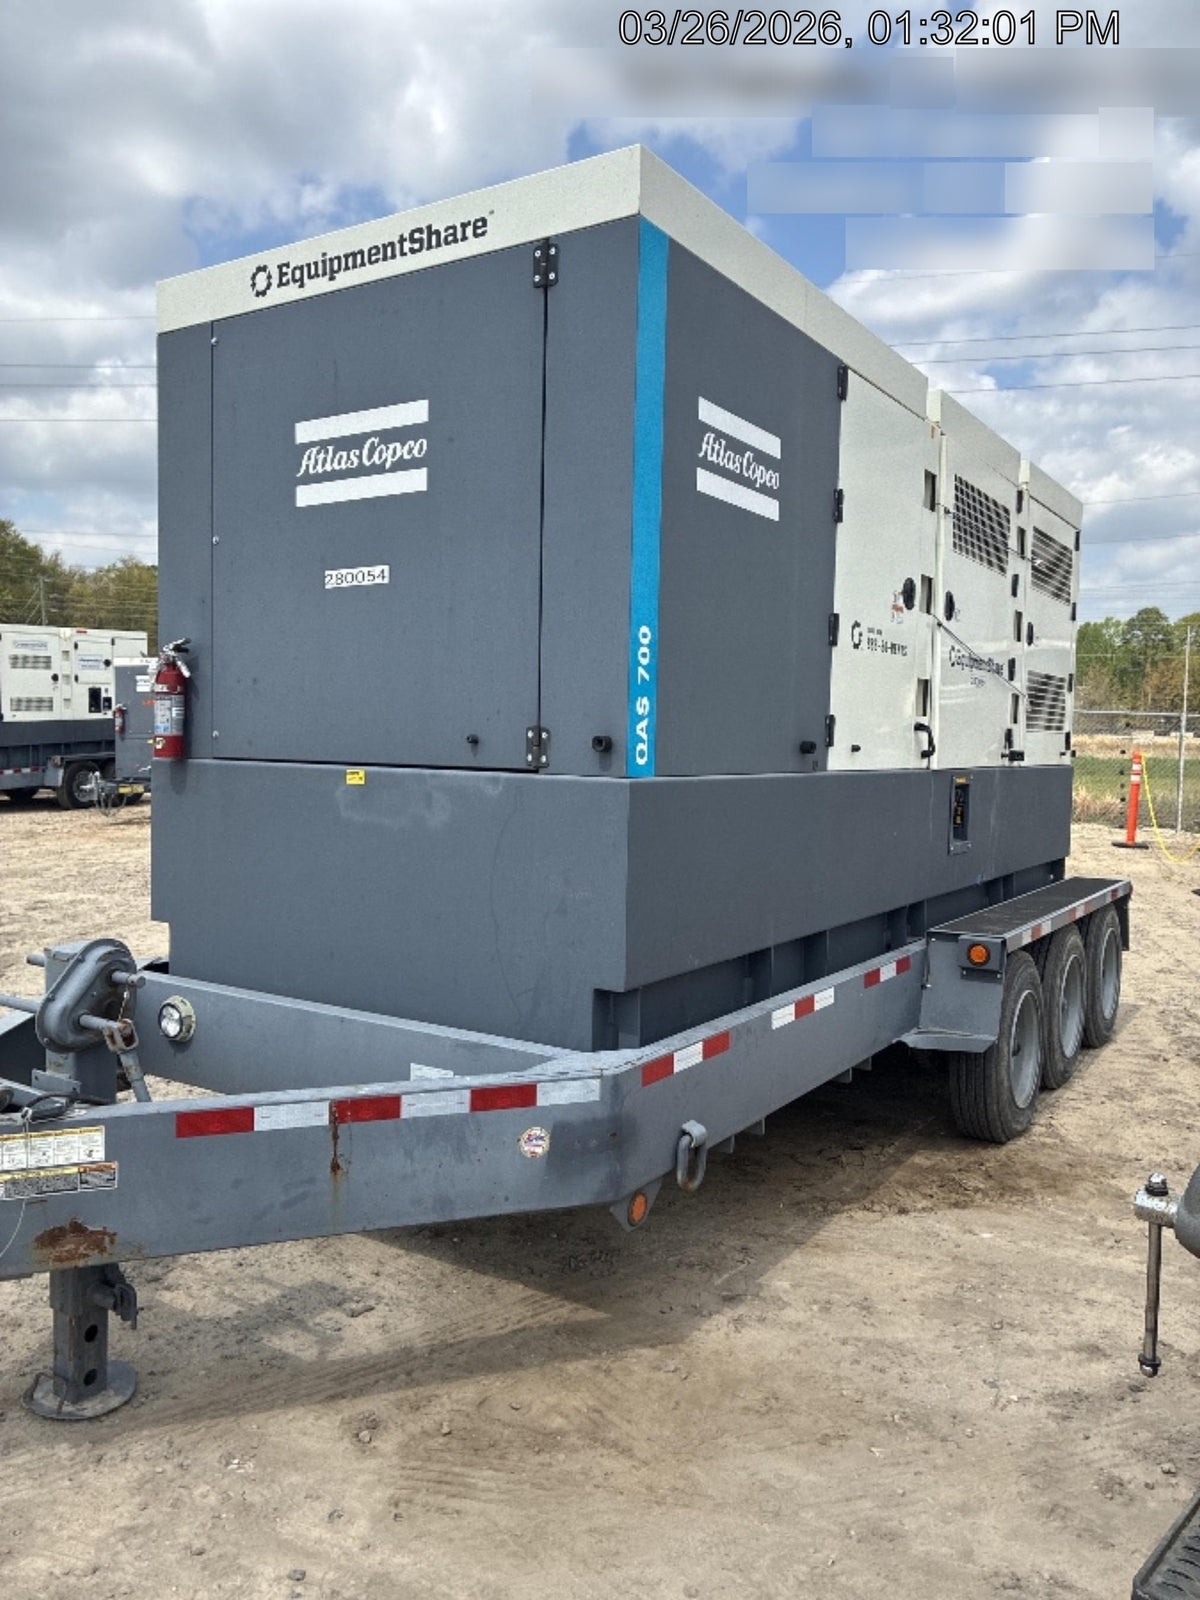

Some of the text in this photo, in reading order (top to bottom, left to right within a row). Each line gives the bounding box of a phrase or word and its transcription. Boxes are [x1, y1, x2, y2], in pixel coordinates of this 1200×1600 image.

[277, 215, 489, 289] EquipmentShare
[296, 436, 428, 477] Atlas Copco
[698, 431, 780, 490] Atlas Copco
[325, 568, 387, 586] 280054
[635, 625, 652, 766] QAS 700
